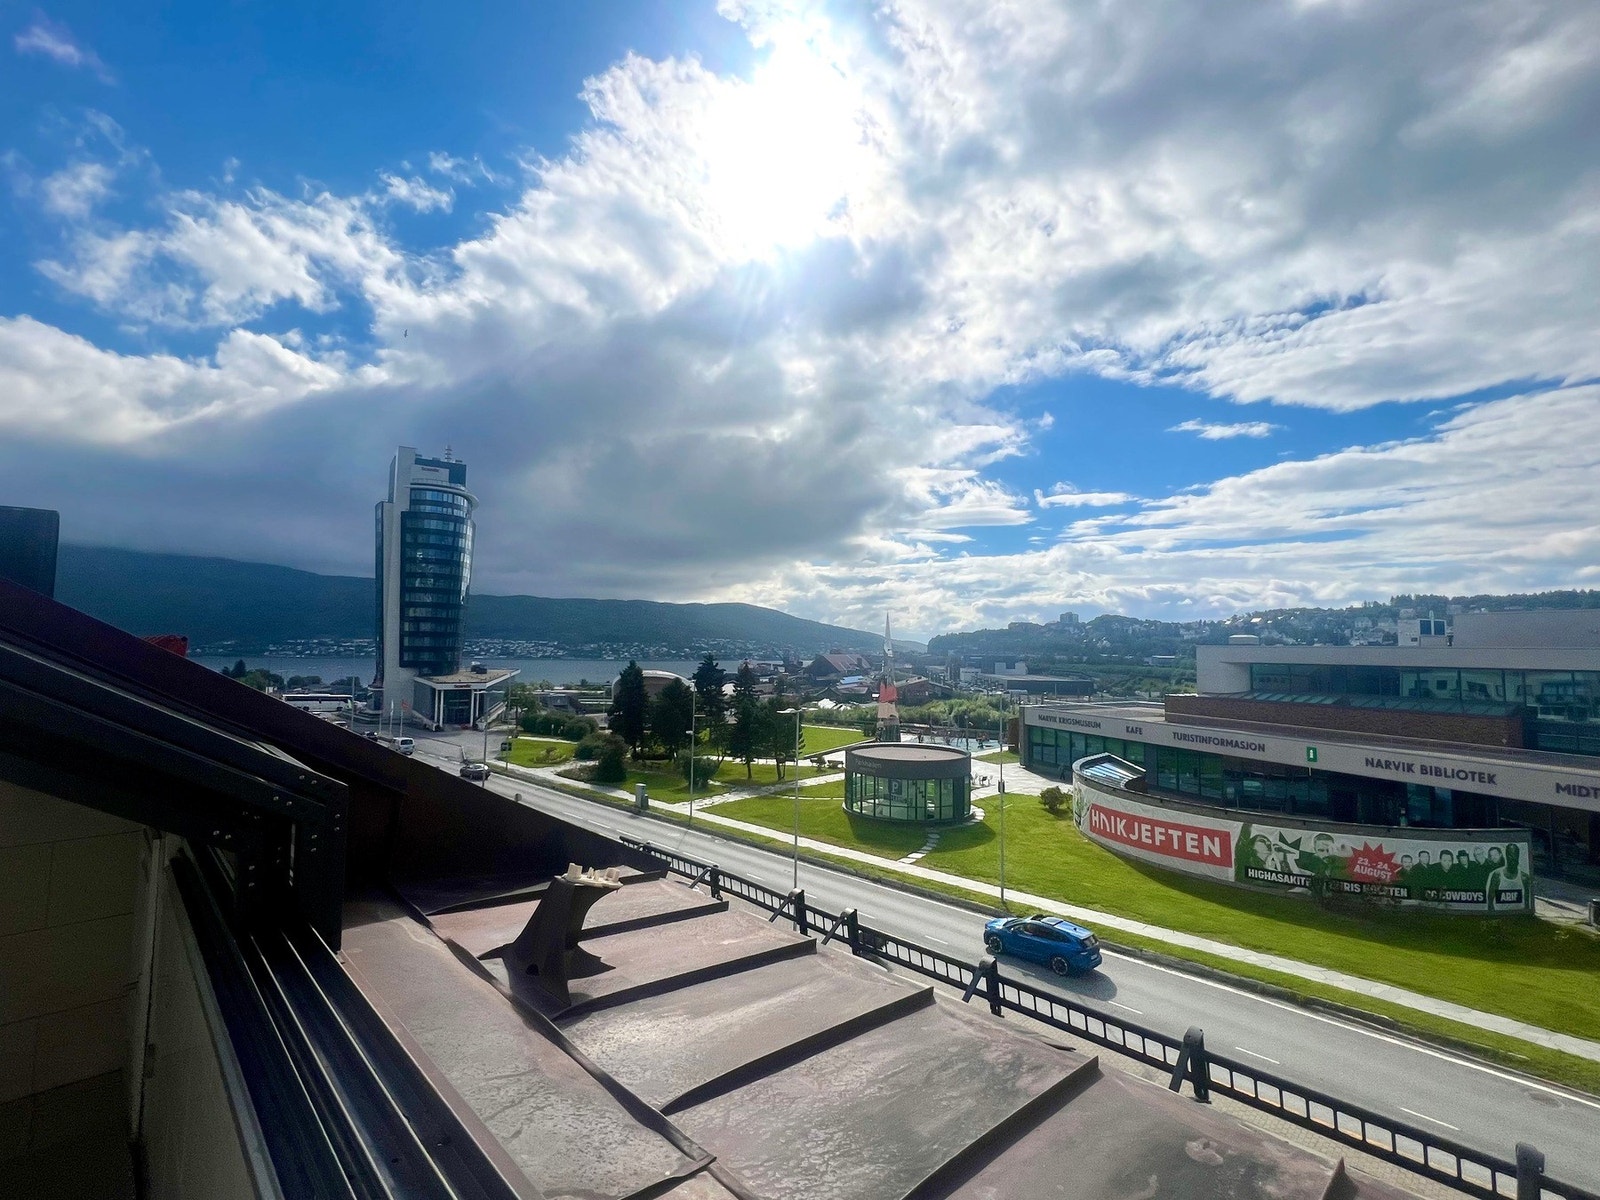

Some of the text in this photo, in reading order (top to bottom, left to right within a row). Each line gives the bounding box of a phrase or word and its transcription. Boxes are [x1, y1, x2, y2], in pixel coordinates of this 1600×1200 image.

[1125, 725, 1143, 736] KAFE
[1172, 731, 1266, 753] TURISTINFORMASJON
[1365, 757, 1497, 786] NARVIK BIBLIOTEK
[1353, 864, 1393, 881] AUGUST
[1501, 891, 1518, 902] ARIF
